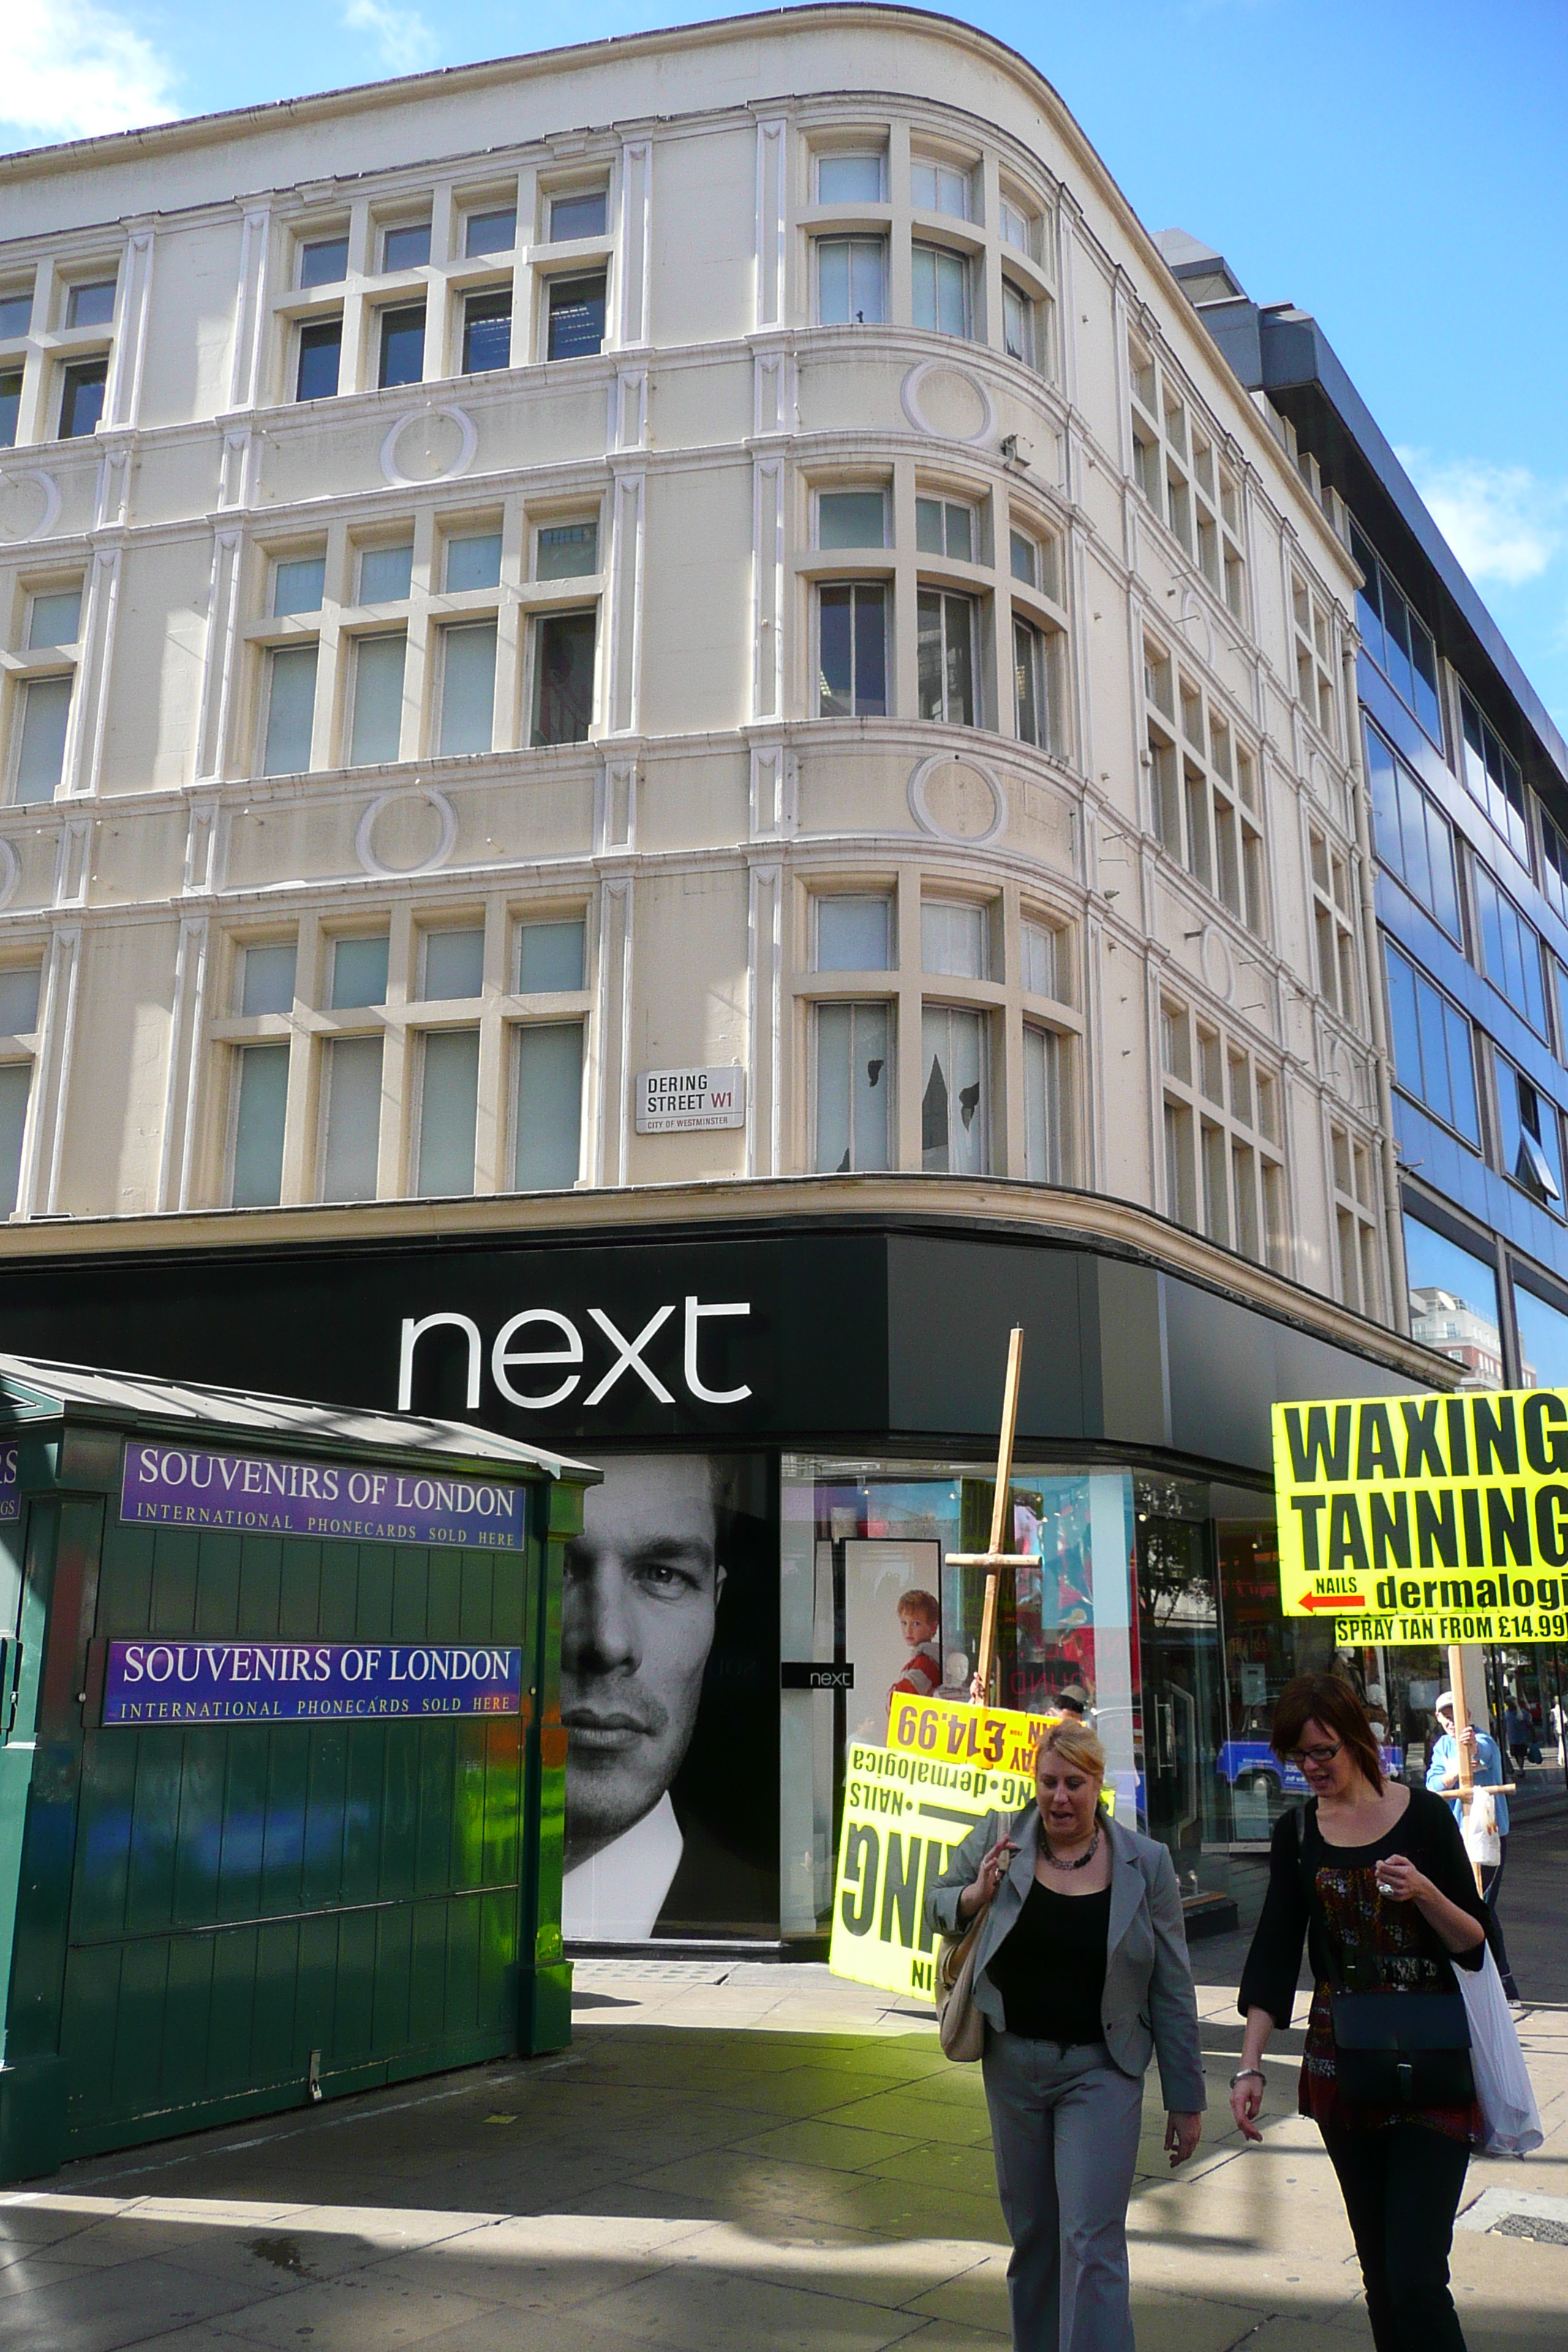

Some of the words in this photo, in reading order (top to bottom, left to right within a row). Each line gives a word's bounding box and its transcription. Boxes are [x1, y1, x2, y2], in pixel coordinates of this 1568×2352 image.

[648, 1074, 708, 1093] DERING
[647, 1093, 705, 1112] STREET
[711, 1092, 731, 1108] W1
[647, 1120, 663, 1129] CITY
[666, 1120, 675, 1128] OF
[677, 1117, 728, 1127] WESTMINSTER
[398, 1296, 752, 1411] next
[1284, 1392, 1568, 1483] WAXING
[139, 1449, 339, 1501] SOUVENIRS
[348, 1473, 388, 1504] OF
[395, 1478, 515, 1518] LONDON
[137, 1502, 293, 1529] INTERNATIONAL
[308, 1517, 416, 1538] PHONECARDS
[429, 1528, 467, 1542] SOLD
[478, 1531, 514, 1546] HERE
[1290, 1484, 1568, 1571] TANNING
[1316, 1577, 1358, 1594] NAILS
[1338, 1618, 1393, 1640] SPRAY
[1399, 1617, 1434, 1639] TAN
[1440, 1616, 1493, 1638] FROM
[1499, 1615, 1564, 1637] £14.99
[124, 1646, 331, 1681] SOUVENIRS
[341, 1649, 382, 1681] OF
[388, 1650, 511, 1681] LONDON
[810, 1672, 851, 1686] next
[121, 1701, 282, 1719] INTERNATIONAL
[298, 1699, 409, 1714] PHONECARDS
[422, 1697, 461, 1711] SOLD
[473, 1697, 510, 1711] HERE
[897, 1705, 1006, 1763] £14.99
[853, 1749, 987, 1798] dermalogica
[850, 1782, 904, 1817] NAILS
